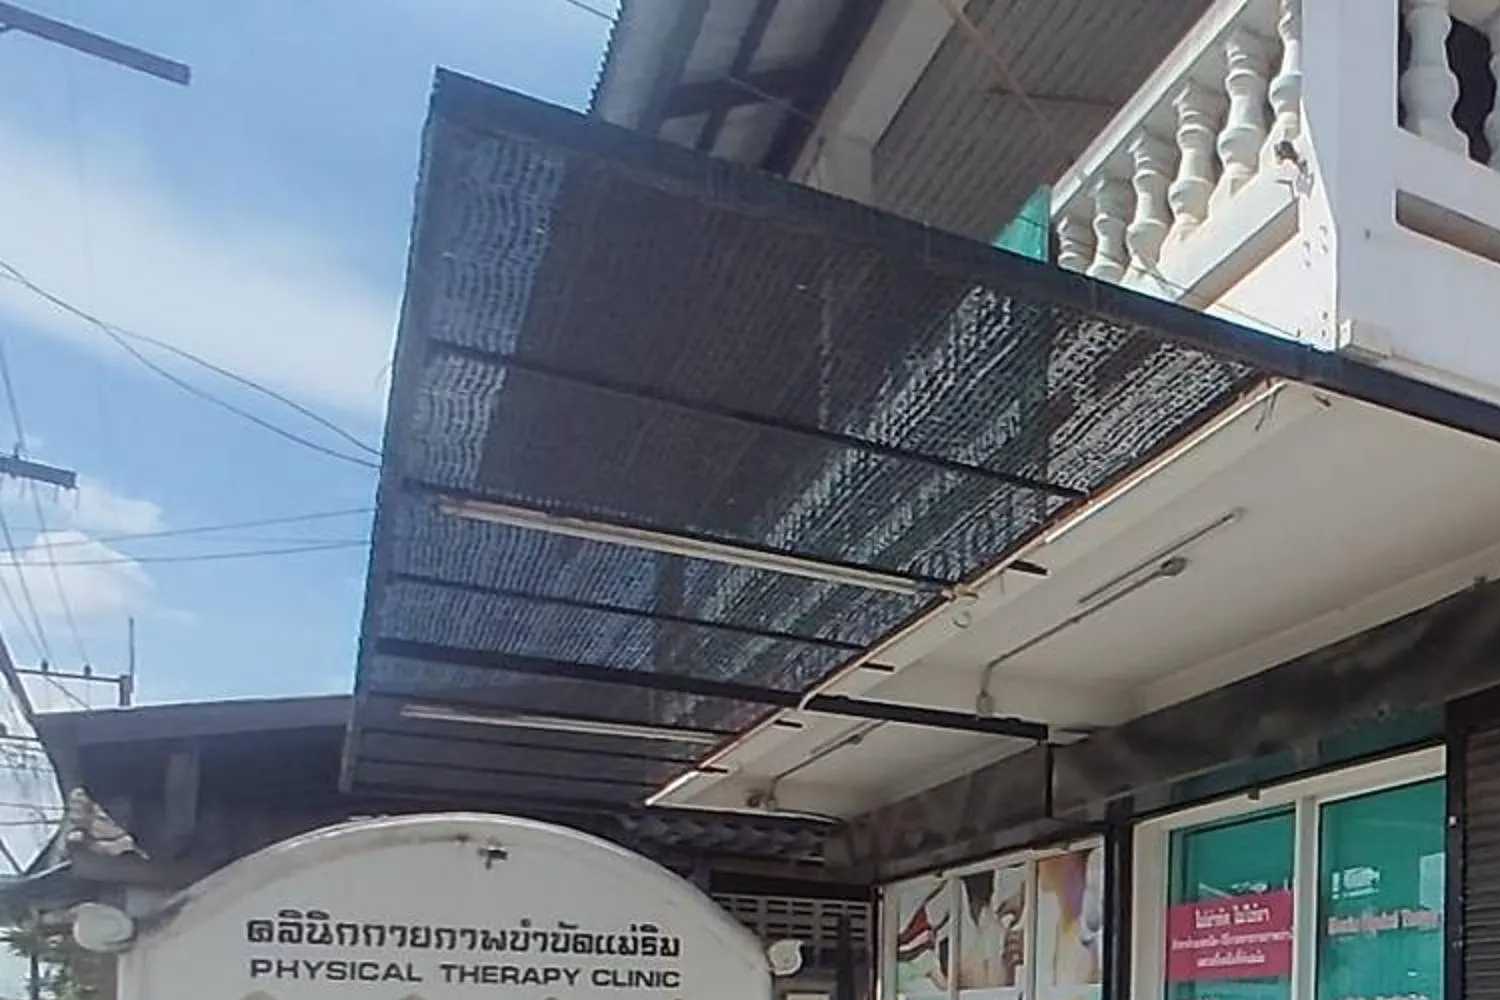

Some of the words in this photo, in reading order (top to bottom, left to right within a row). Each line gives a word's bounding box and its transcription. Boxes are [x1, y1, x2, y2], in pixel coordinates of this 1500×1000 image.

[247, 908, 681, 957] คลินิกกายภาพบำบัดแม่ริม
[250, 958, 423, 982] PHYSICAL
[439, 963, 581, 987] THERAPY
[591, 968, 681, 988] CLINIC
